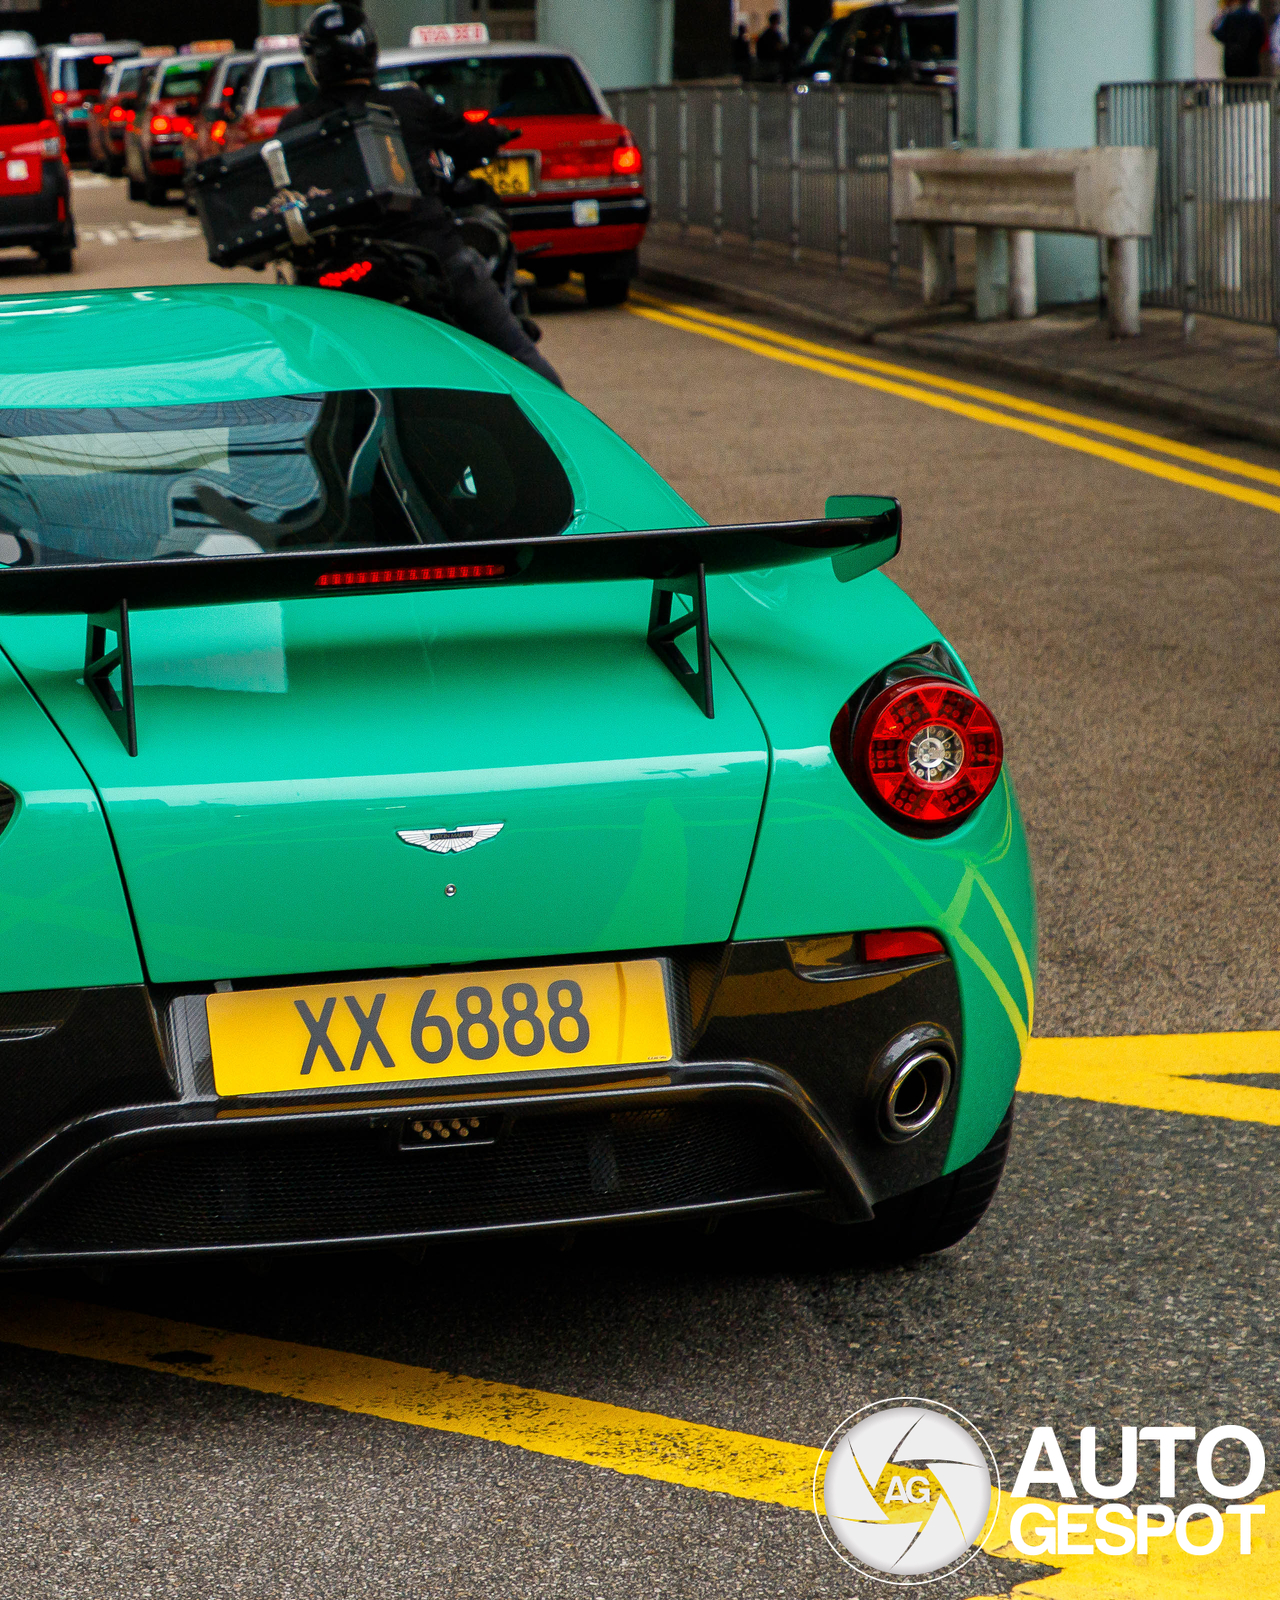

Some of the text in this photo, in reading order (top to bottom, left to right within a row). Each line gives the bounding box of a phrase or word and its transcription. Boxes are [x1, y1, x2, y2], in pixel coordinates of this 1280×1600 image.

[419, 26, 483, 43] TAXI
[294, 979, 590, 1076] XX 6888
